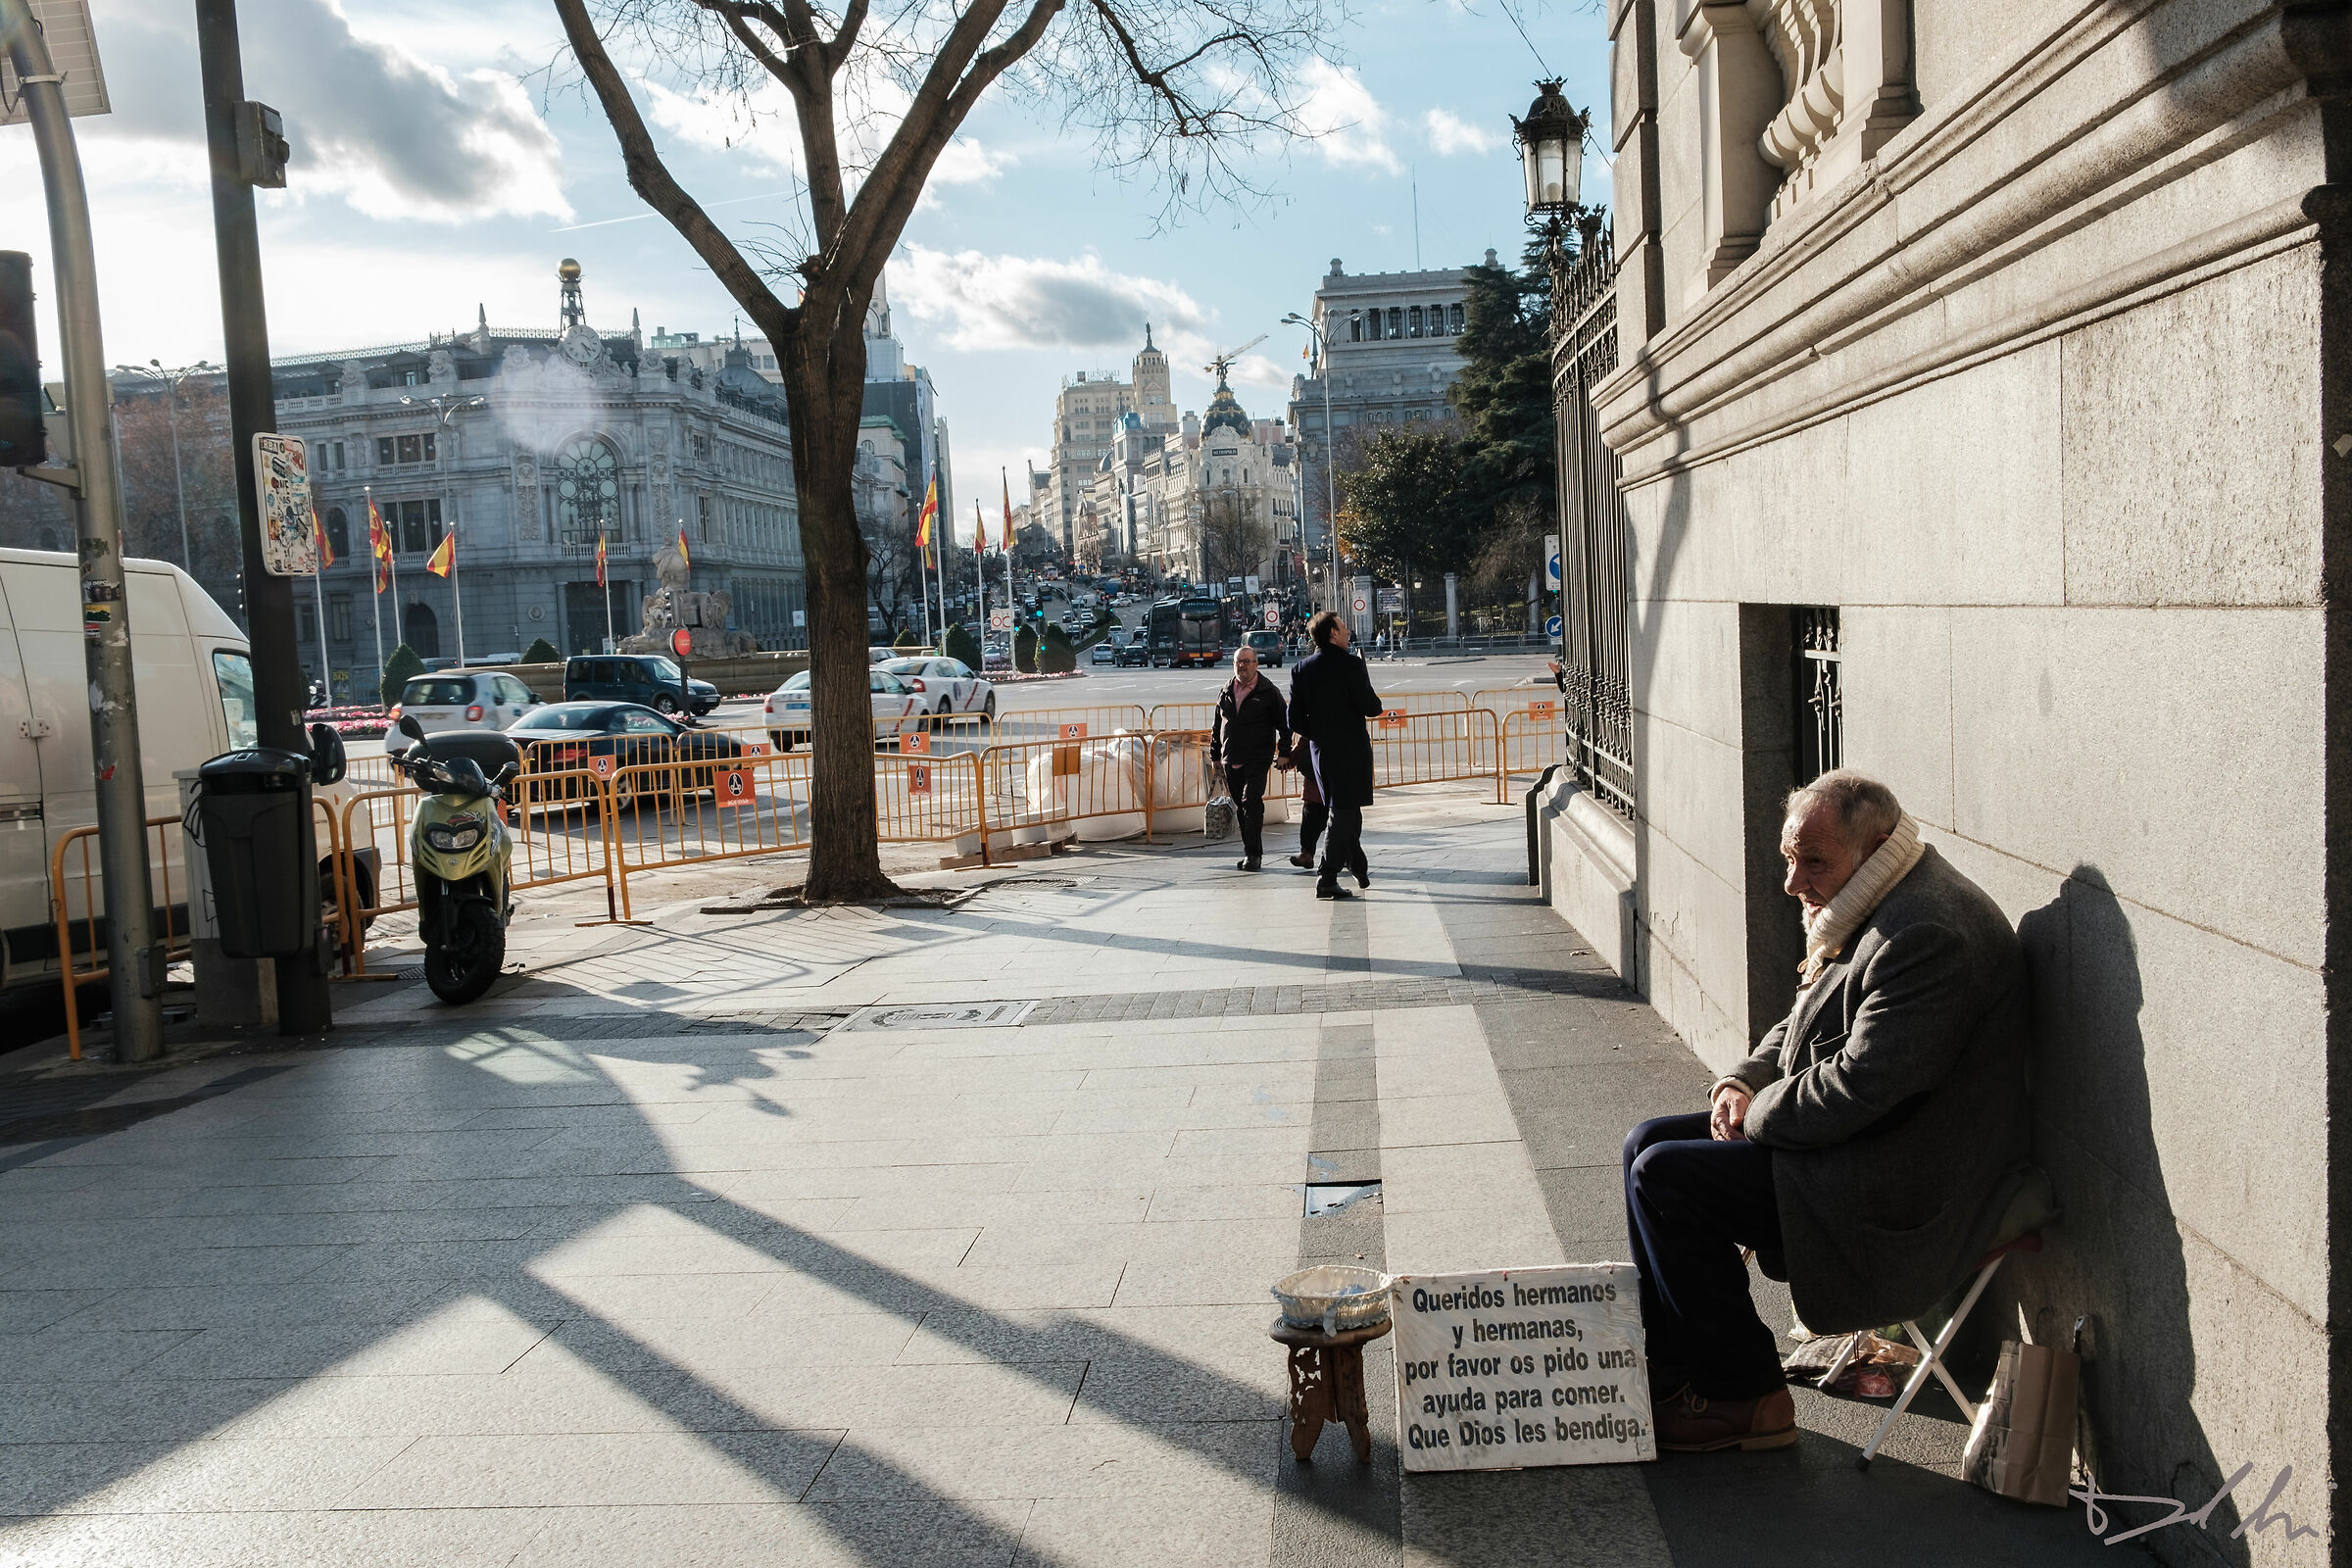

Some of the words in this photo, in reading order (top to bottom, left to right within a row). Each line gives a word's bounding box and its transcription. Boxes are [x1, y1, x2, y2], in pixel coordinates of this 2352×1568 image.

[1412, 1285, 1505, 1313] Queridos
[1513, 1283, 1617, 1306] hermanos
[1451, 1325, 1464, 1349] y
[1472, 1318, 1583, 1343] hermanas,
[1404, 1359, 1440, 1386] por
[1447, 1352, 1501, 1378] favor
[1510, 1354, 1535, 1375] os
[1544, 1347, 1589, 1378] pido
[1597, 1348, 1638, 1370] una
[1423, 1386, 1487, 1418] ayuda
[1494, 1389, 1544, 1415] para
[1551, 1384, 1626, 1407] comer.
[1408, 1423, 1450, 1450] Que
[1458, 1419, 1506, 1446] Dios
[1514, 1418, 1546, 1444] les
[1554, 1412, 1646, 1445] bendiga.
